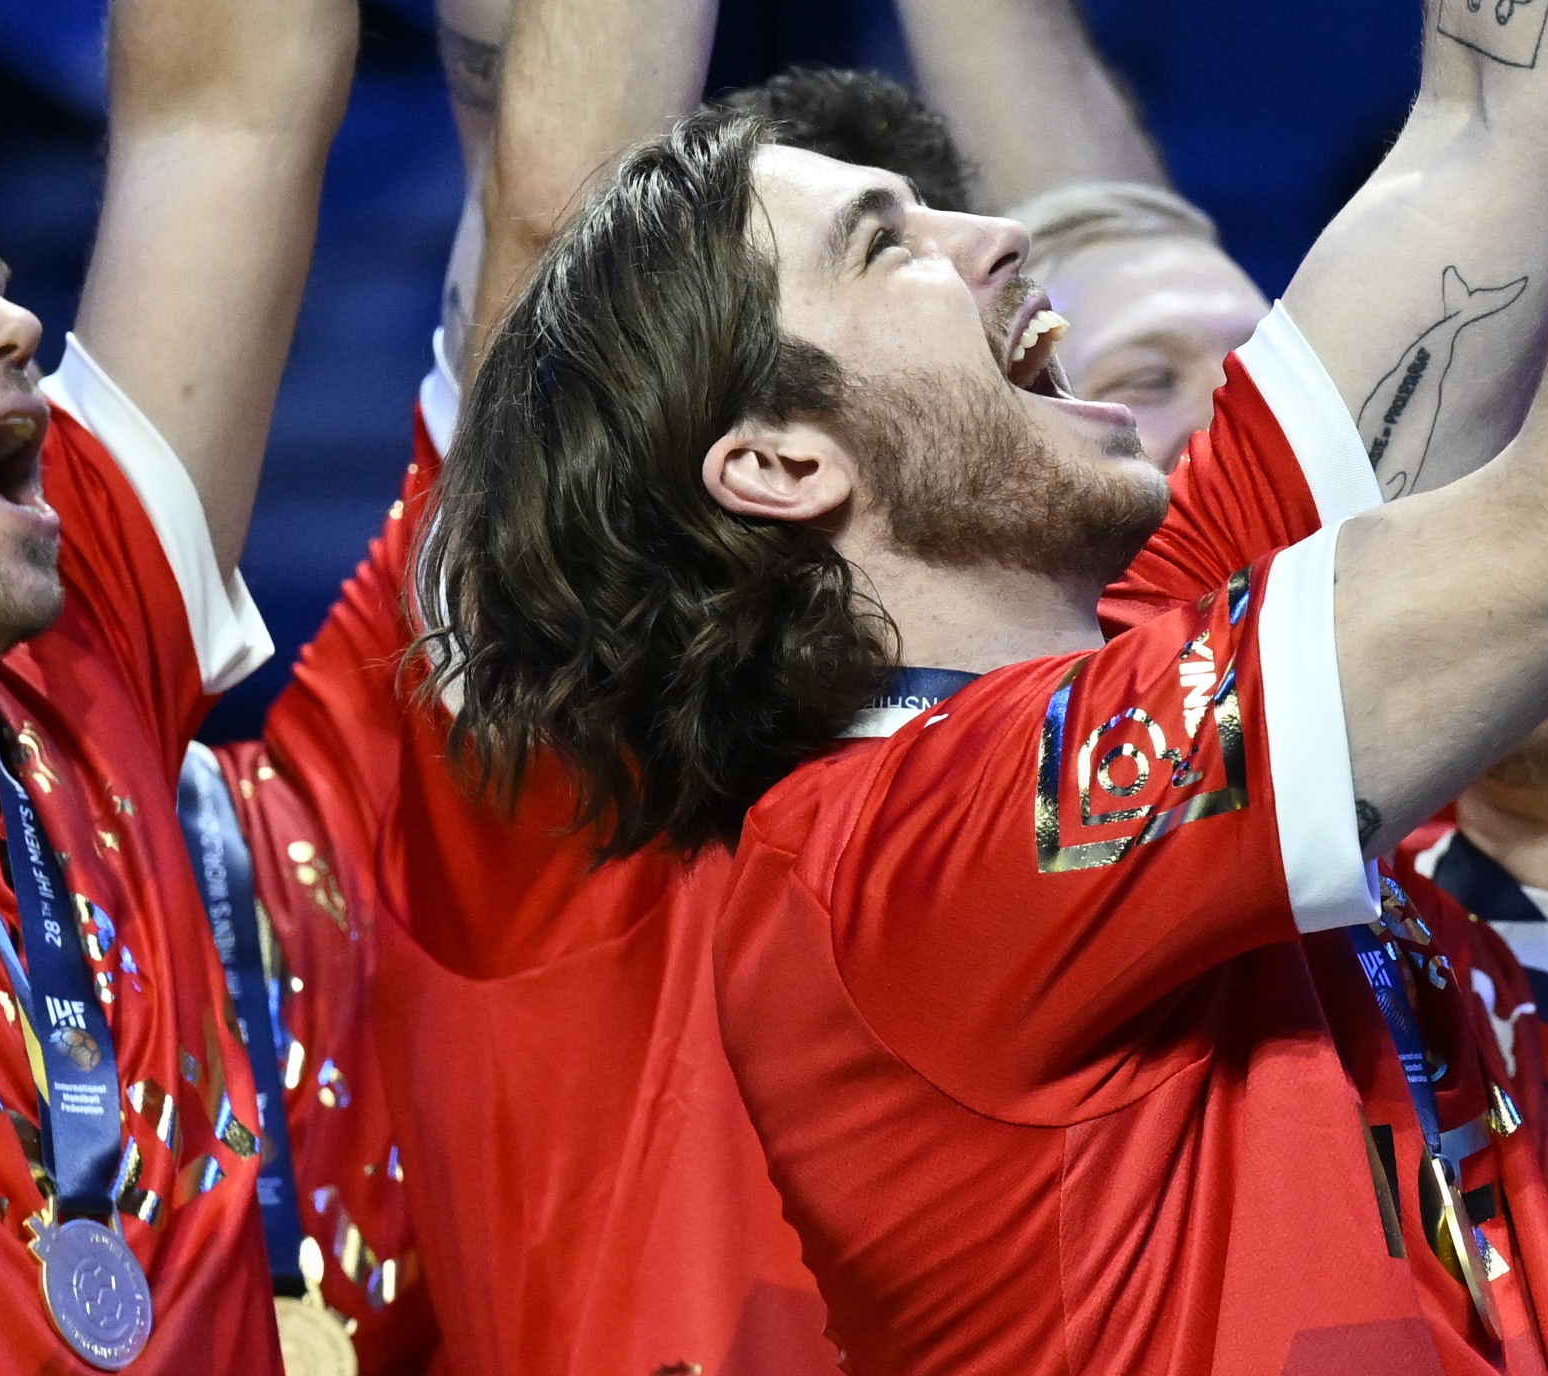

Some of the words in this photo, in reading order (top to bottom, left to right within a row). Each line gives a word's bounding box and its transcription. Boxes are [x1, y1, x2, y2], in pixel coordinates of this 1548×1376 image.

[19, 803, 46, 870] MEN'S
[33, 869, 55, 901] IHF
[45, 995, 86, 1030] IHF
